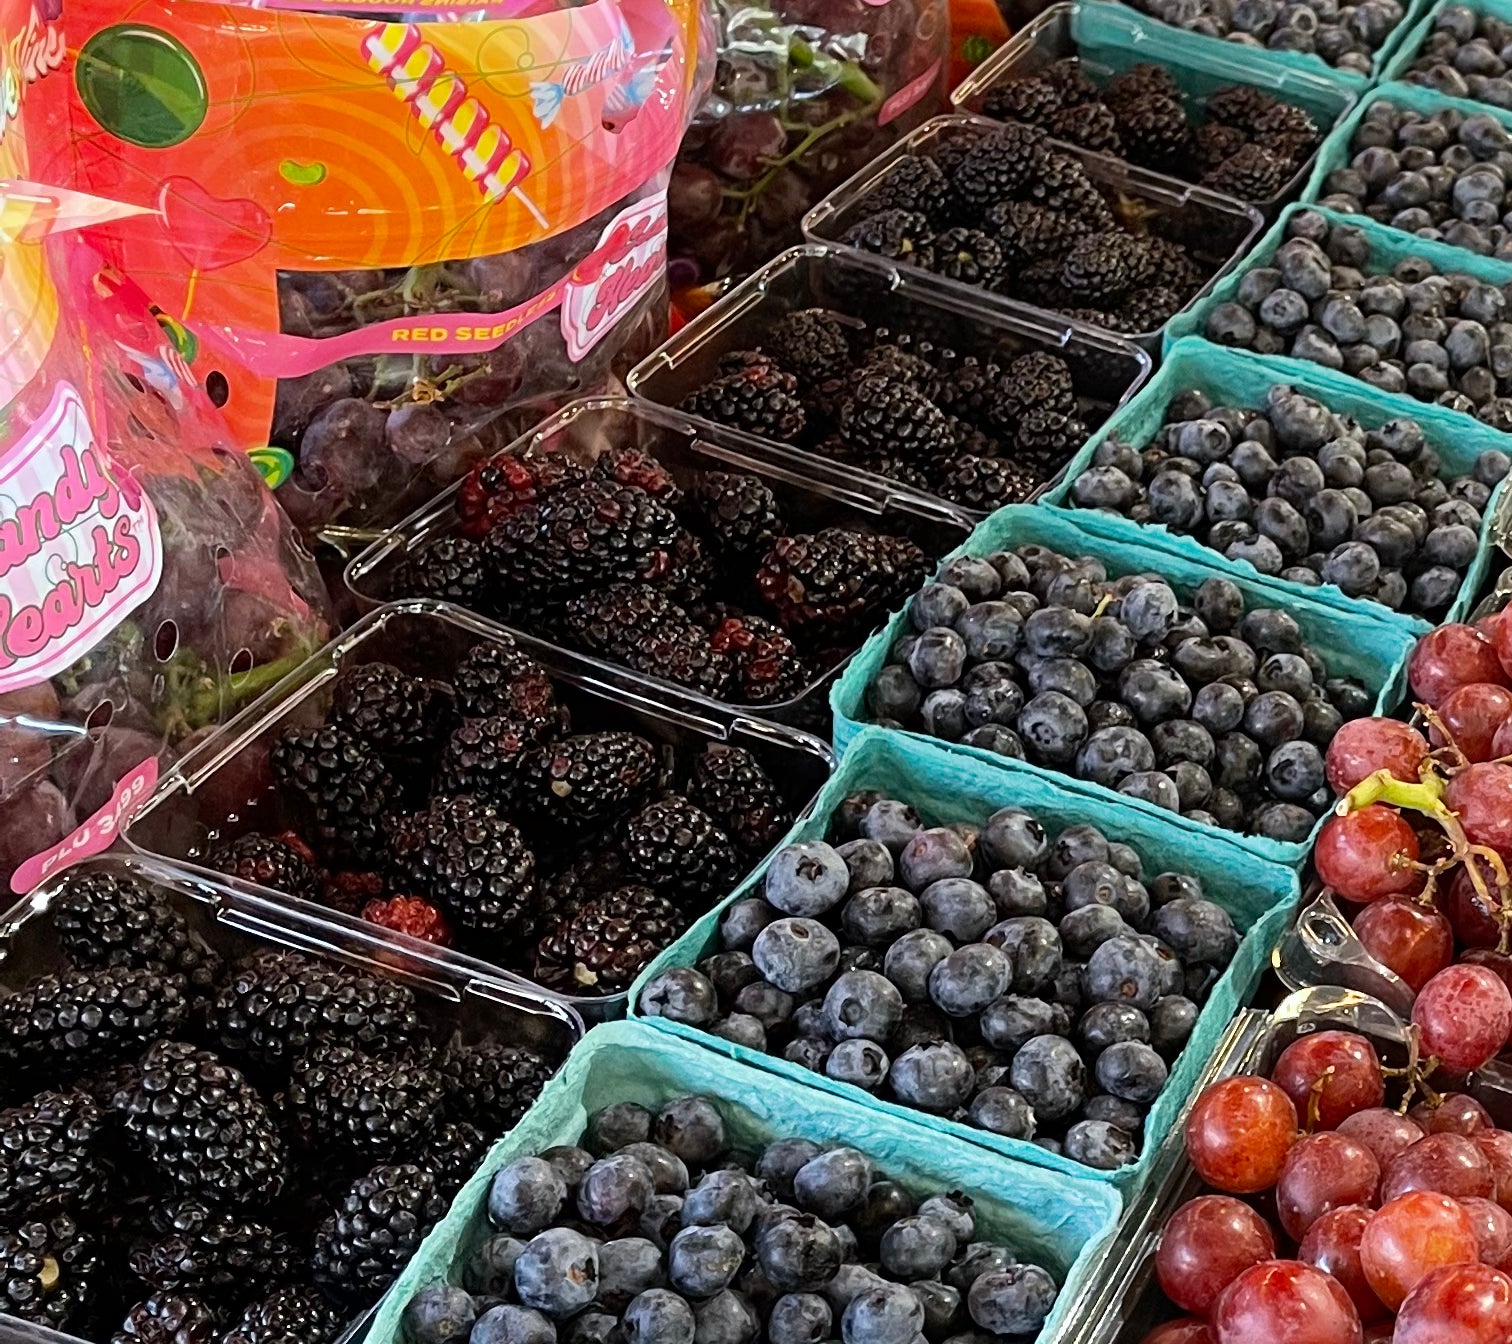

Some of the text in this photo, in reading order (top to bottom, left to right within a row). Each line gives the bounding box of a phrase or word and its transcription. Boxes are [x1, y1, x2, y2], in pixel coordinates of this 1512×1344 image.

[391, 327, 449, 342] RED
[0, 442, 120, 578] andy
[0, 515, 141, 670] earts
[41, 827, 91, 874] PLU
